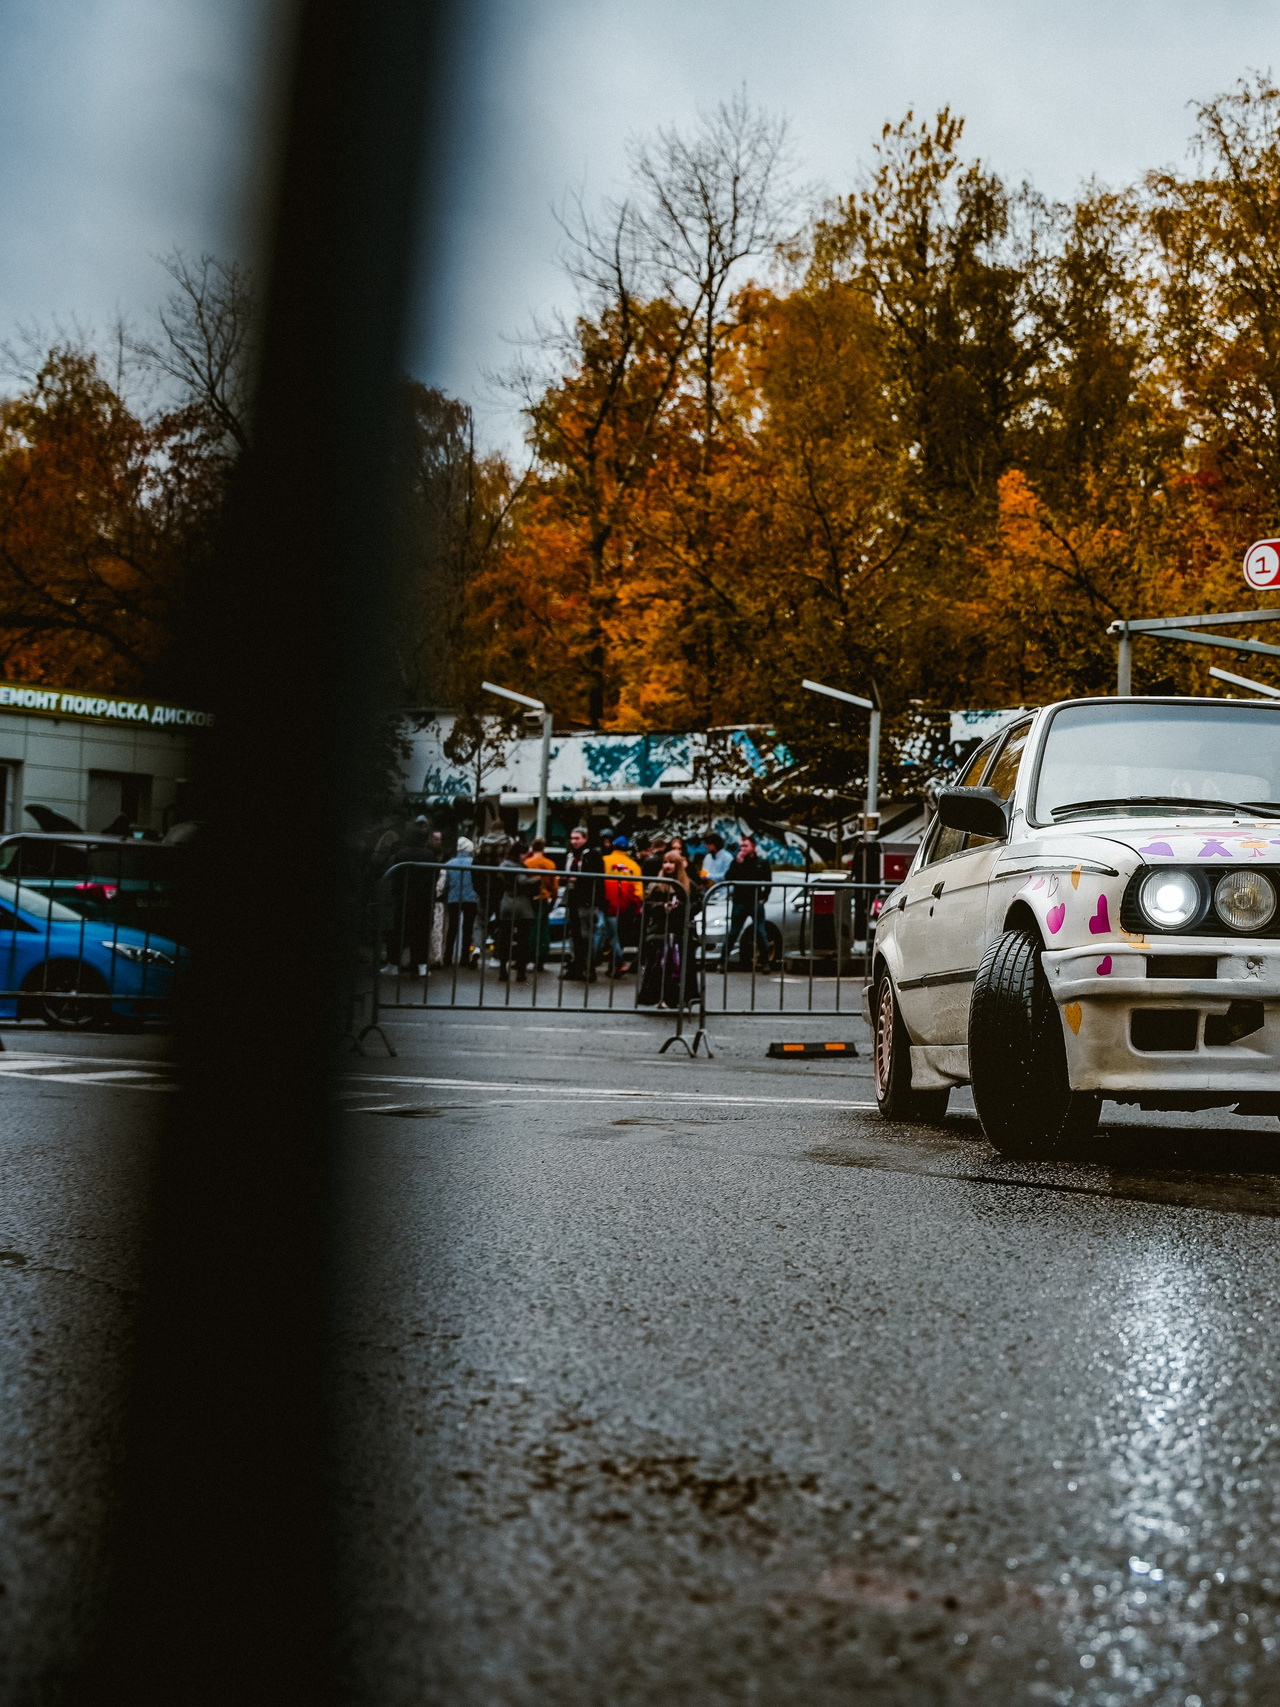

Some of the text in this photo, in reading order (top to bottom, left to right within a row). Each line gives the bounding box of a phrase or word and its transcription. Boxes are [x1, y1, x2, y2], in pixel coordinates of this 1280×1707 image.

[1255, 556, 1271, 575] 1
[60, 694, 150, 722] ПОКРАСКА
[151, 706, 216, 728] ДИСКОВ
